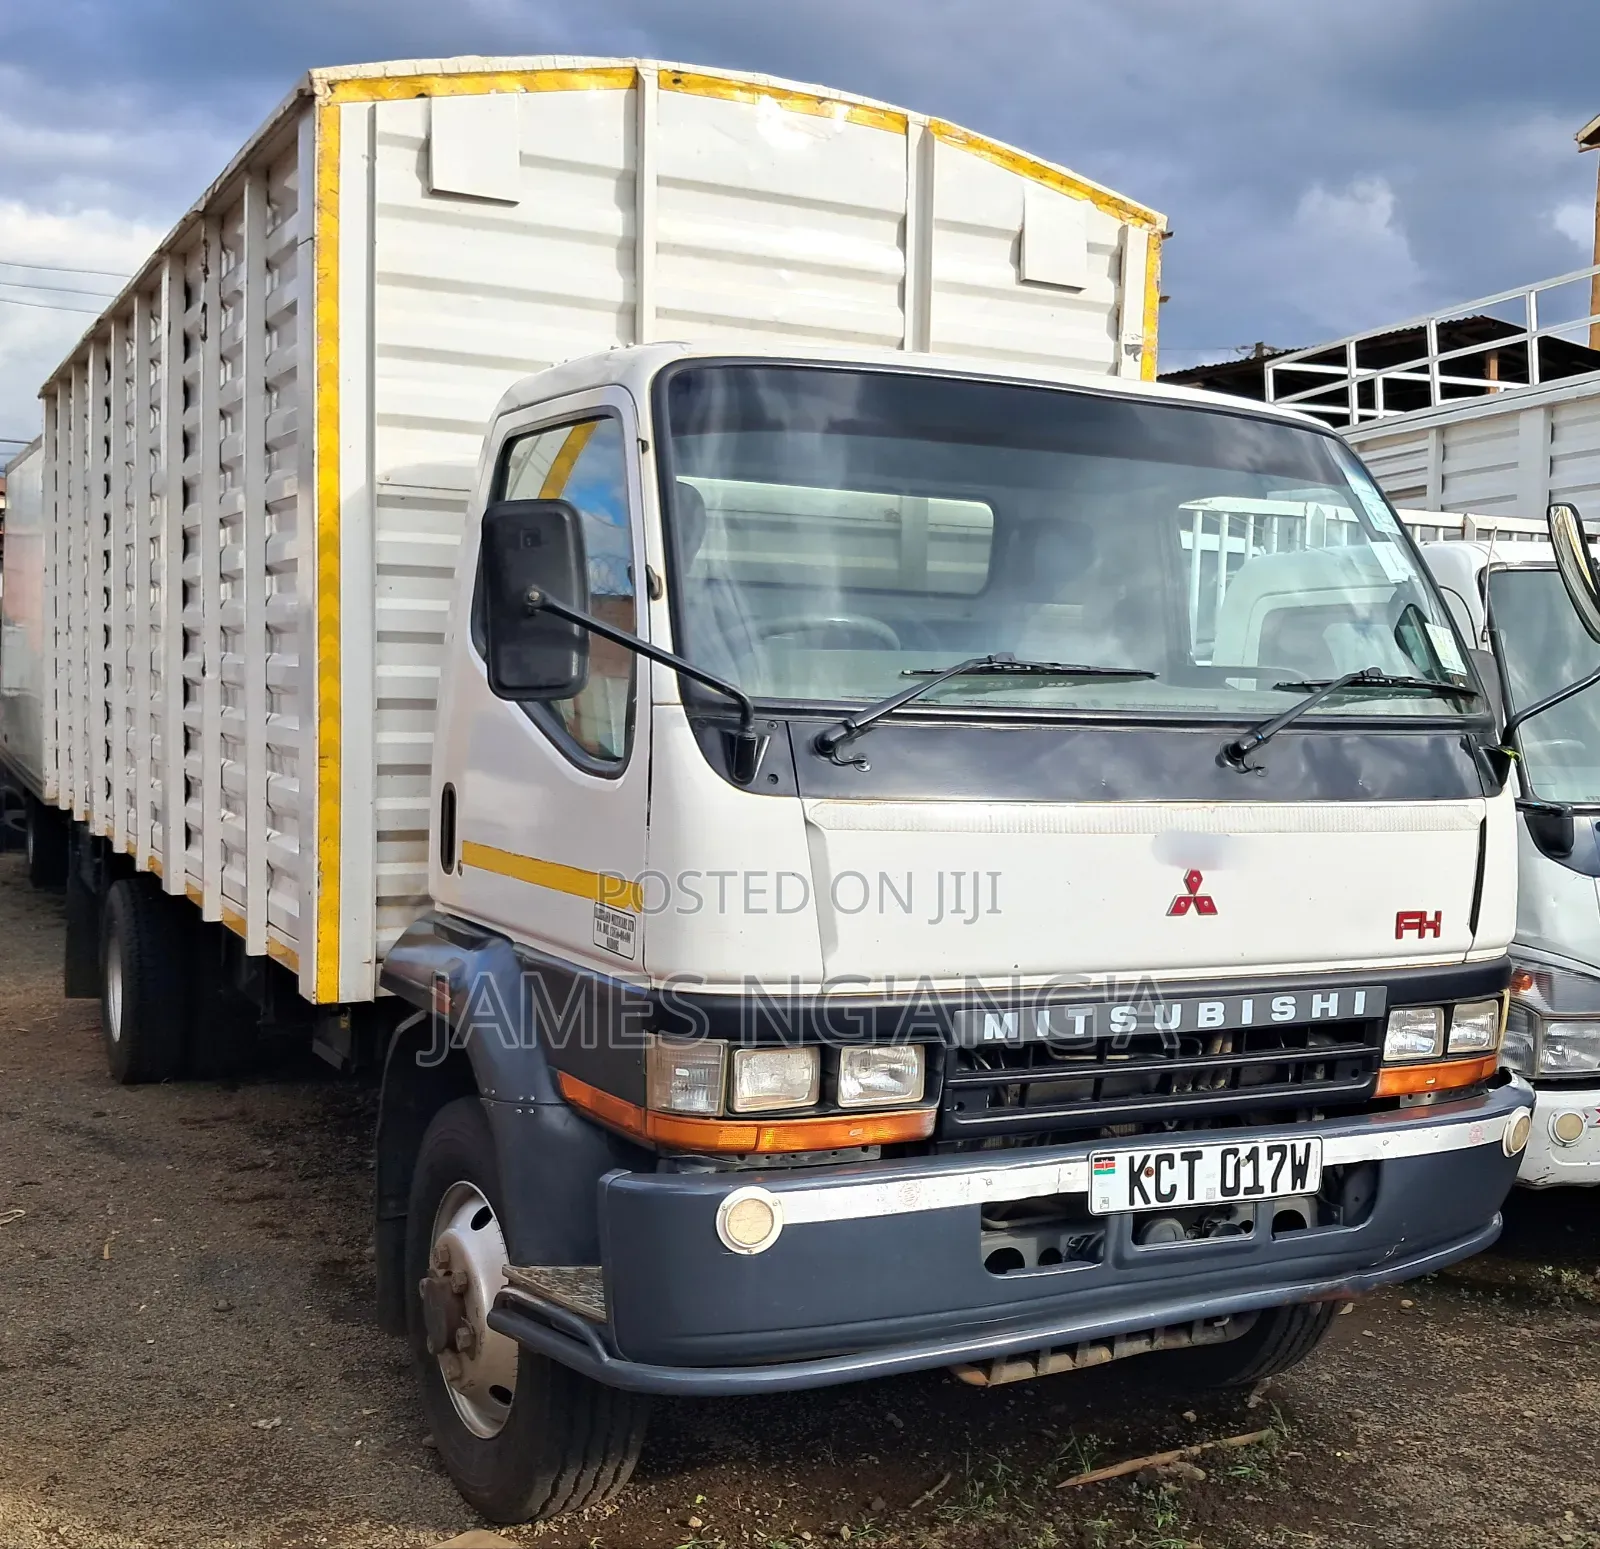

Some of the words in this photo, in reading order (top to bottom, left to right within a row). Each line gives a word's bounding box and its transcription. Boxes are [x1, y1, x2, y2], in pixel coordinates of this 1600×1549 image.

[1395, 910, 1442, 940] FH
[983, 990, 1367, 1041] MITSUBISHI
[1128, 1150, 1203, 1207] KCT
[1220, 1142, 1312, 1198] 017W
